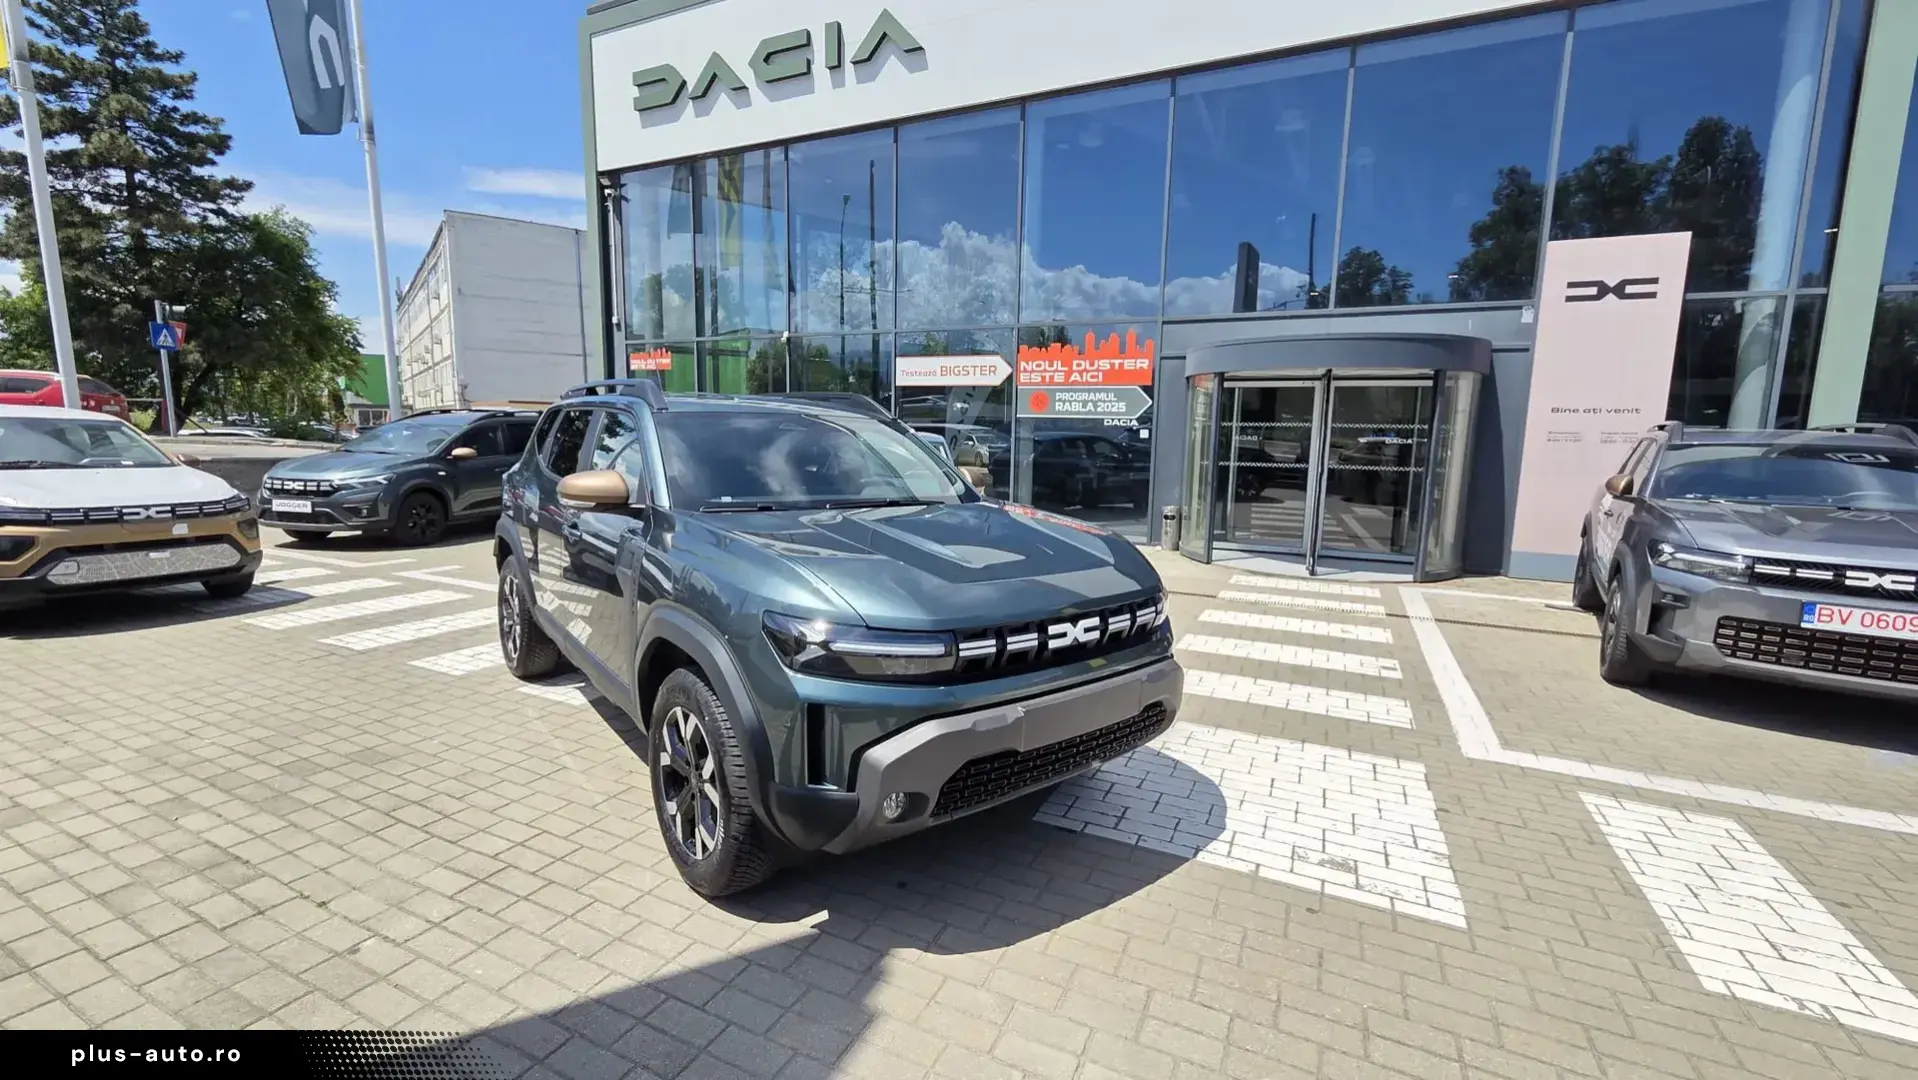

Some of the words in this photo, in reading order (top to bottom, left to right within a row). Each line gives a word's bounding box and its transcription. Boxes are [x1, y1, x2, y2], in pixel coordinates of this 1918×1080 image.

[632, 8, 926, 112] DACIA
[940, 364, 998, 377] BIGSTER
[1020, 360, 1068, 371] NOUL
[1072, 358, 1149, 370] DUSTER
[1020, 372, 1065, 383] ESTE
[1069, 371, 1103, 383] AICI
[1055, 392, 1117, 401] PROGRAMUL
[1055, 402, 1094, 412] RABLA
[1096, 402, 1126, 412] 2025
[1104, 418, 1139, 426] DACIA
[1817, 607, 1853, 625] BV
